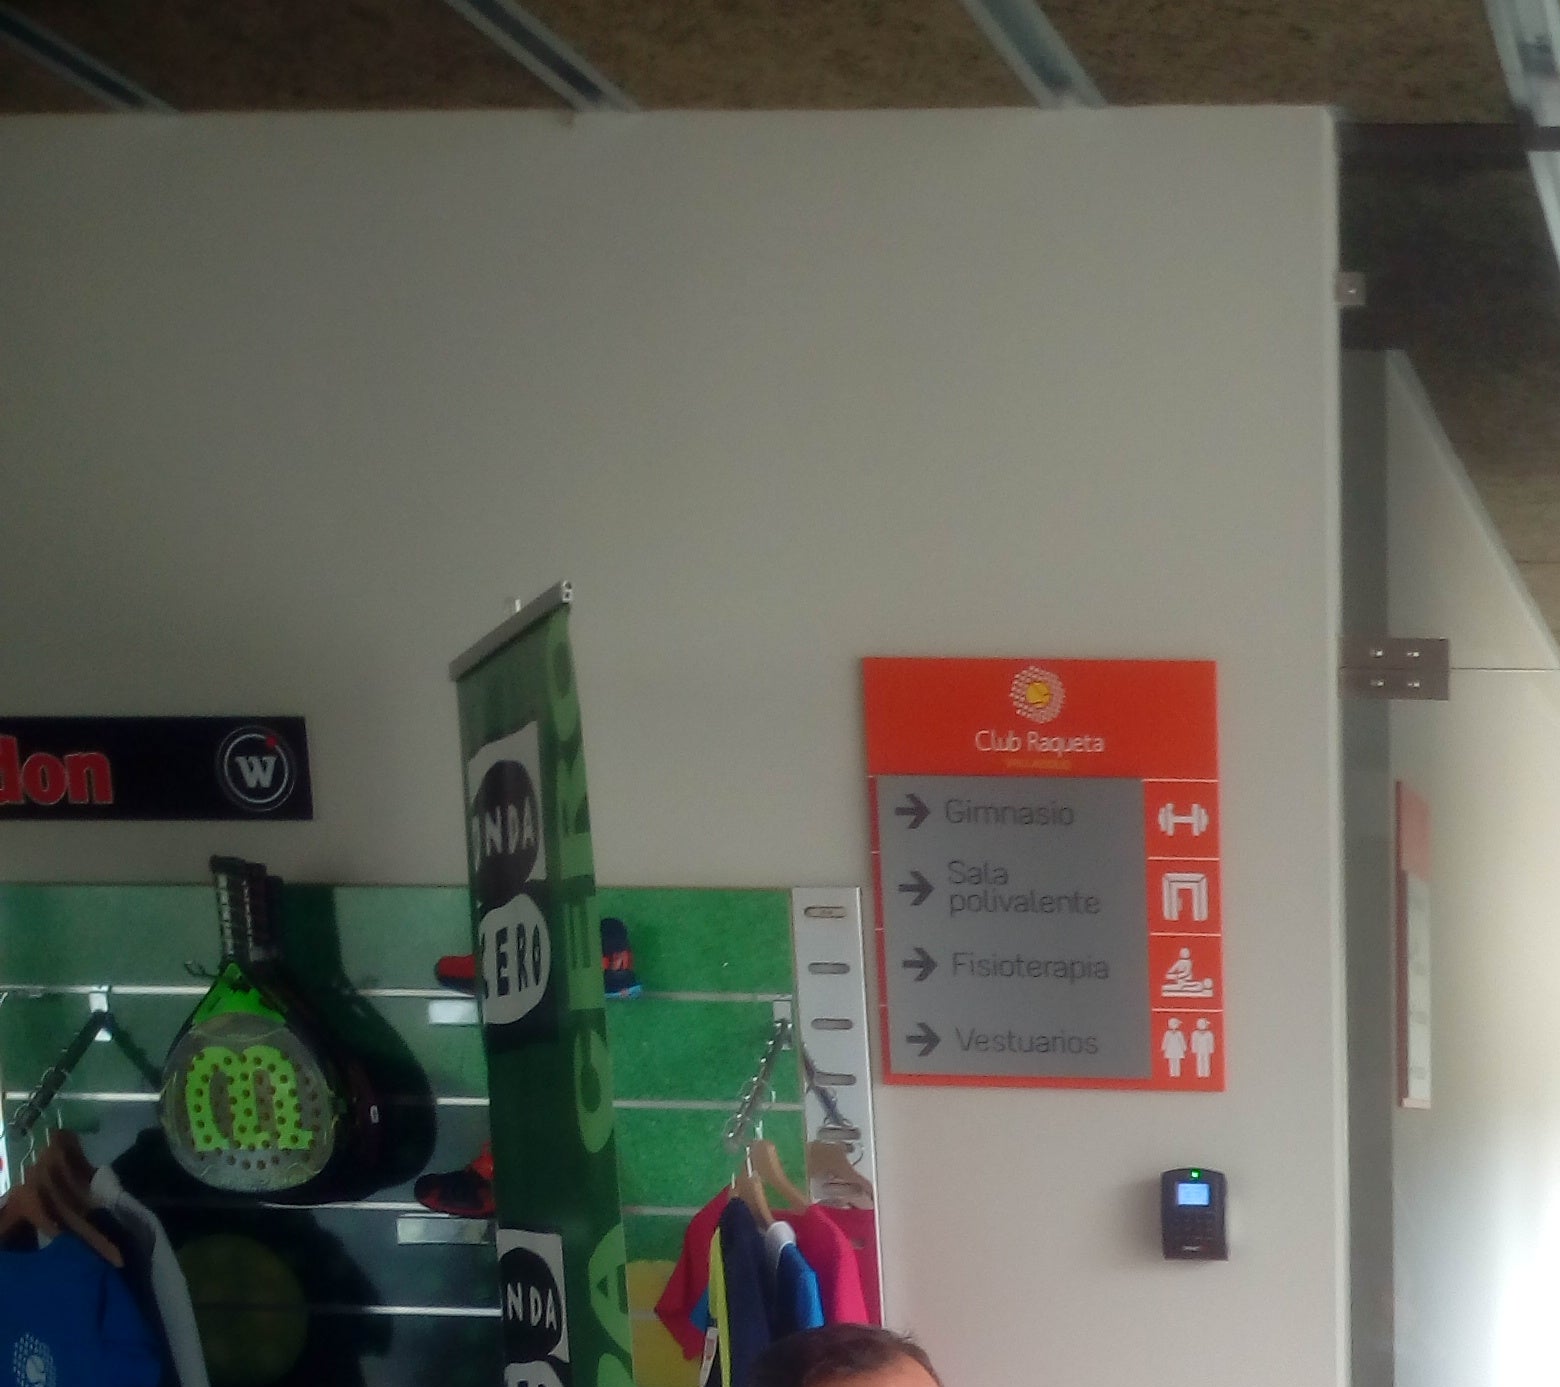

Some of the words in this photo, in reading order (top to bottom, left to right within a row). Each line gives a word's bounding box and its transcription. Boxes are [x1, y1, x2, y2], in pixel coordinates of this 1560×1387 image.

[975, 730, 1022, 752] Club
[1027, 731, 1105, 757] Raqueta
[945, 799, 1075, 826] Gimnasio
[948, 860, 1009, 885] Sala
[950, 890, 1100, 918] polivalente
[952, 952, 1110, 983] Fisioterapia
[955, 1027, 1098, 1054] Vestuarios
[505, 1281, 557, 1331] NDA
